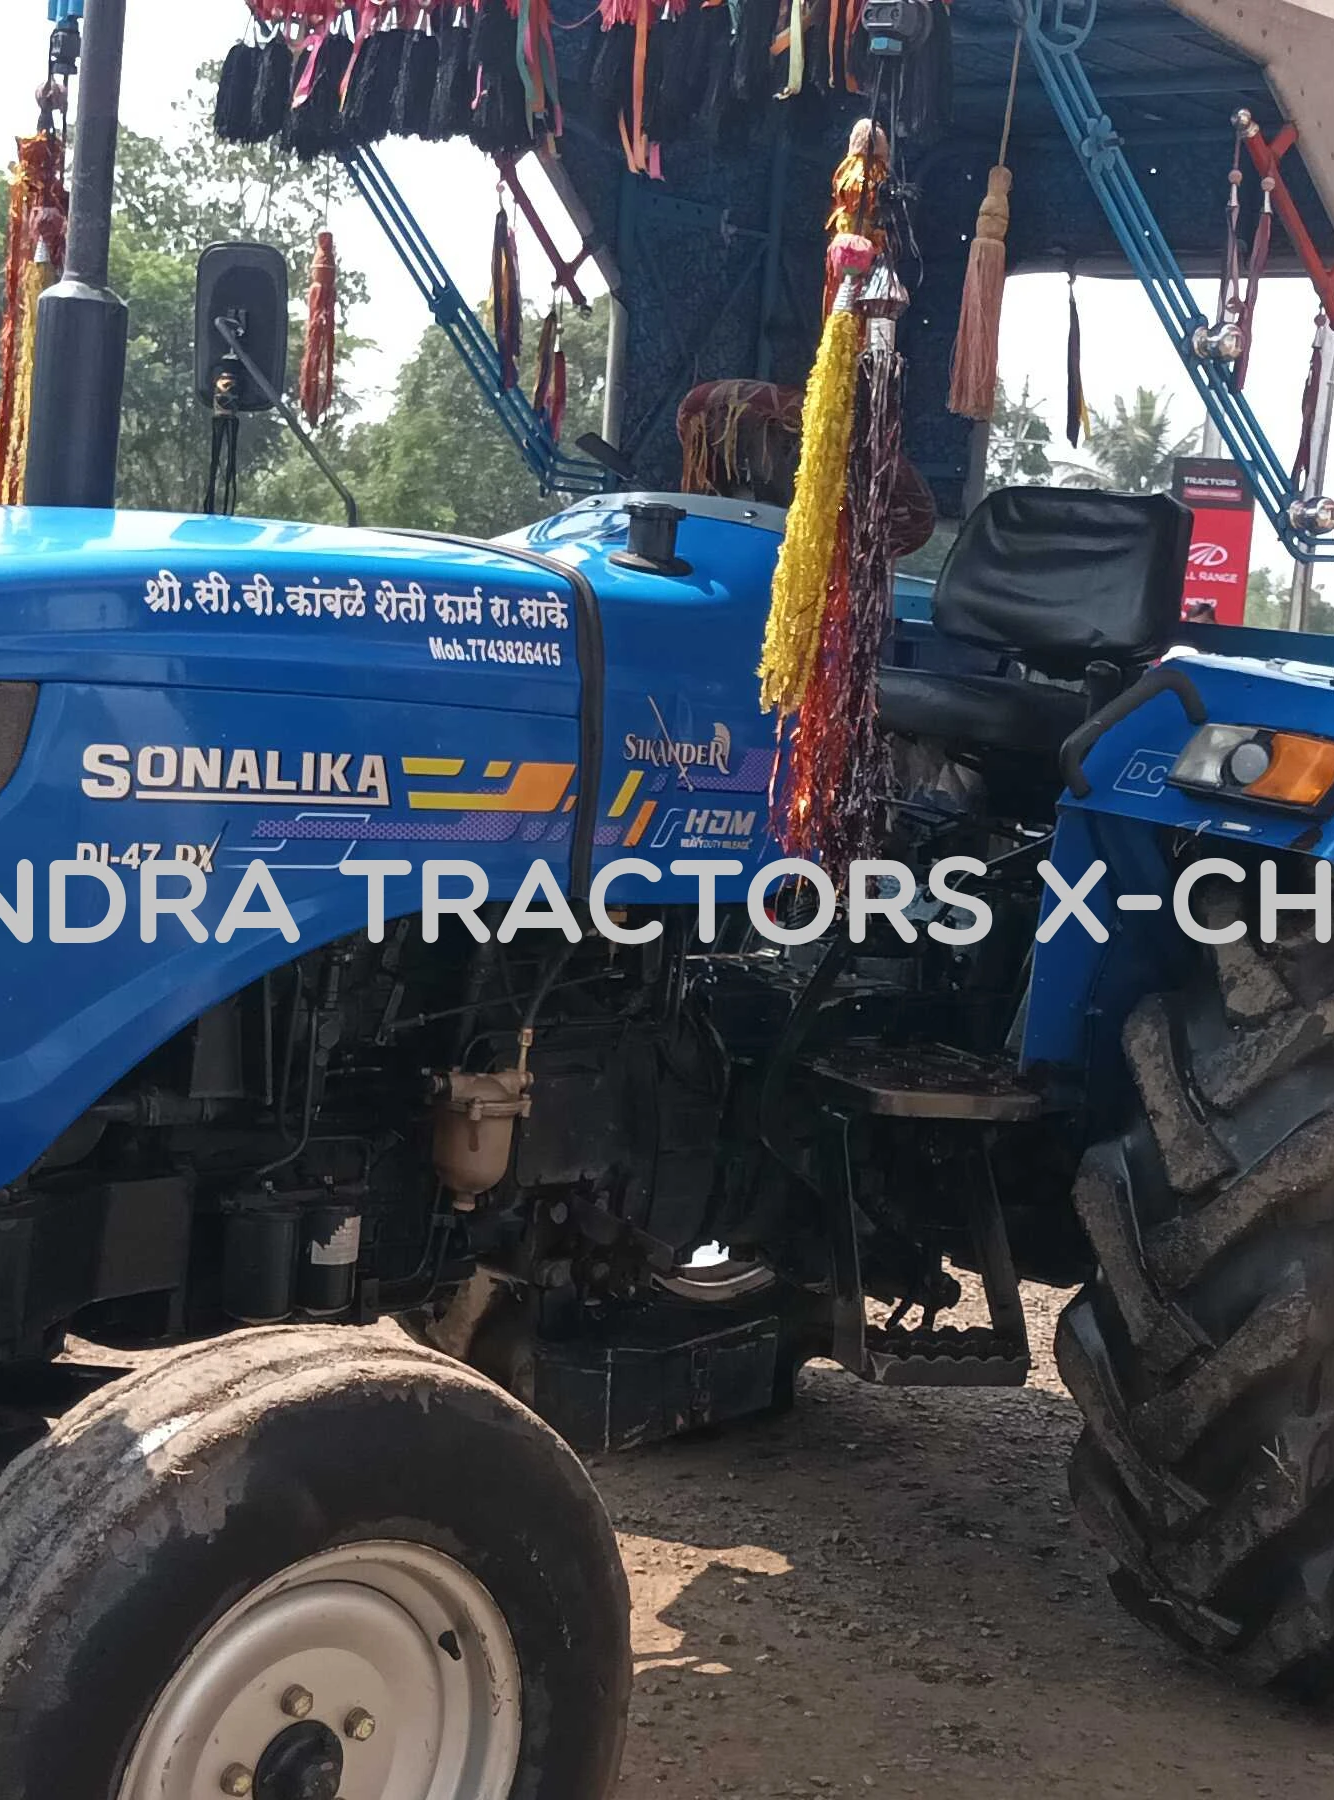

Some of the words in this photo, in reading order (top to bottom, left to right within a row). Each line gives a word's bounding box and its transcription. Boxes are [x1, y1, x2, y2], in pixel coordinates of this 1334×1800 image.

[1183, 475, 1238, 487] TRACTORS
[374, 580, 427, 624] शेती
[432, 586, 483, 625] फार्म
[80, 743, 391, 806] SONALIKA
[623, 728, 732, 776] SIKANDER
[684, 808, 757, 837] HDM
